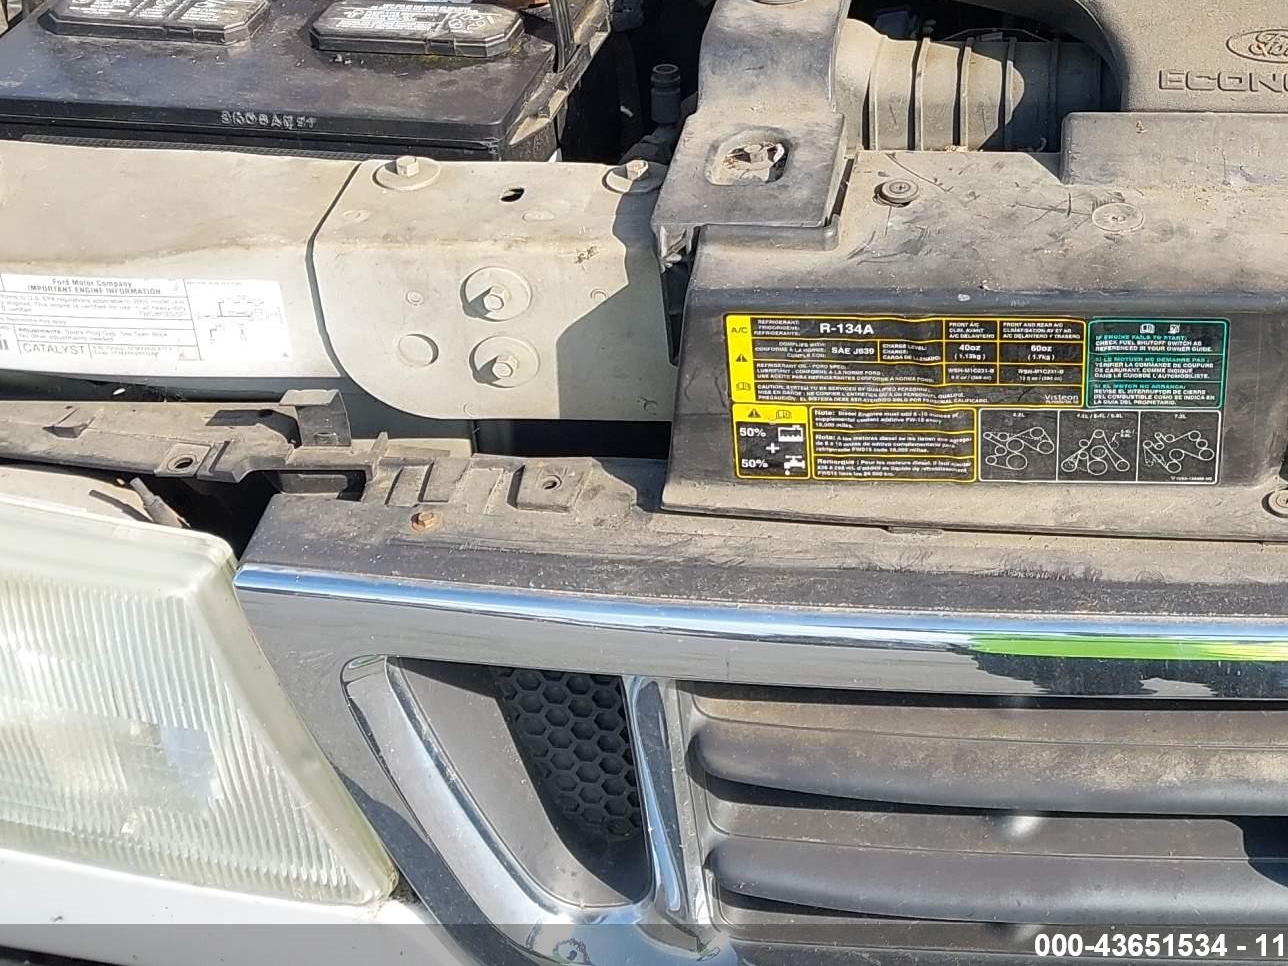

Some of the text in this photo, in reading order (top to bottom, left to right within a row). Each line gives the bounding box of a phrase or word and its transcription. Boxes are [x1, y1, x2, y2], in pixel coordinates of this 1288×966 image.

[52, 278, 132, 288] Ford Motor Company
[28, 285, 161, 295] IMPORTANT ENGINE INFORMATION
[731, 326, 748, 334] A/C
[819, 323, 874, 335] R-134A
[23, 343, 86, 354] CATALYST
[832, 346, 851, 354] SAE
[958, 344, 981, 352] 40oz
[1044, 393, 1079, 401] Visteon
[740, 426, 768, 438] 50%
[742, 459, 769, 469] 50%
